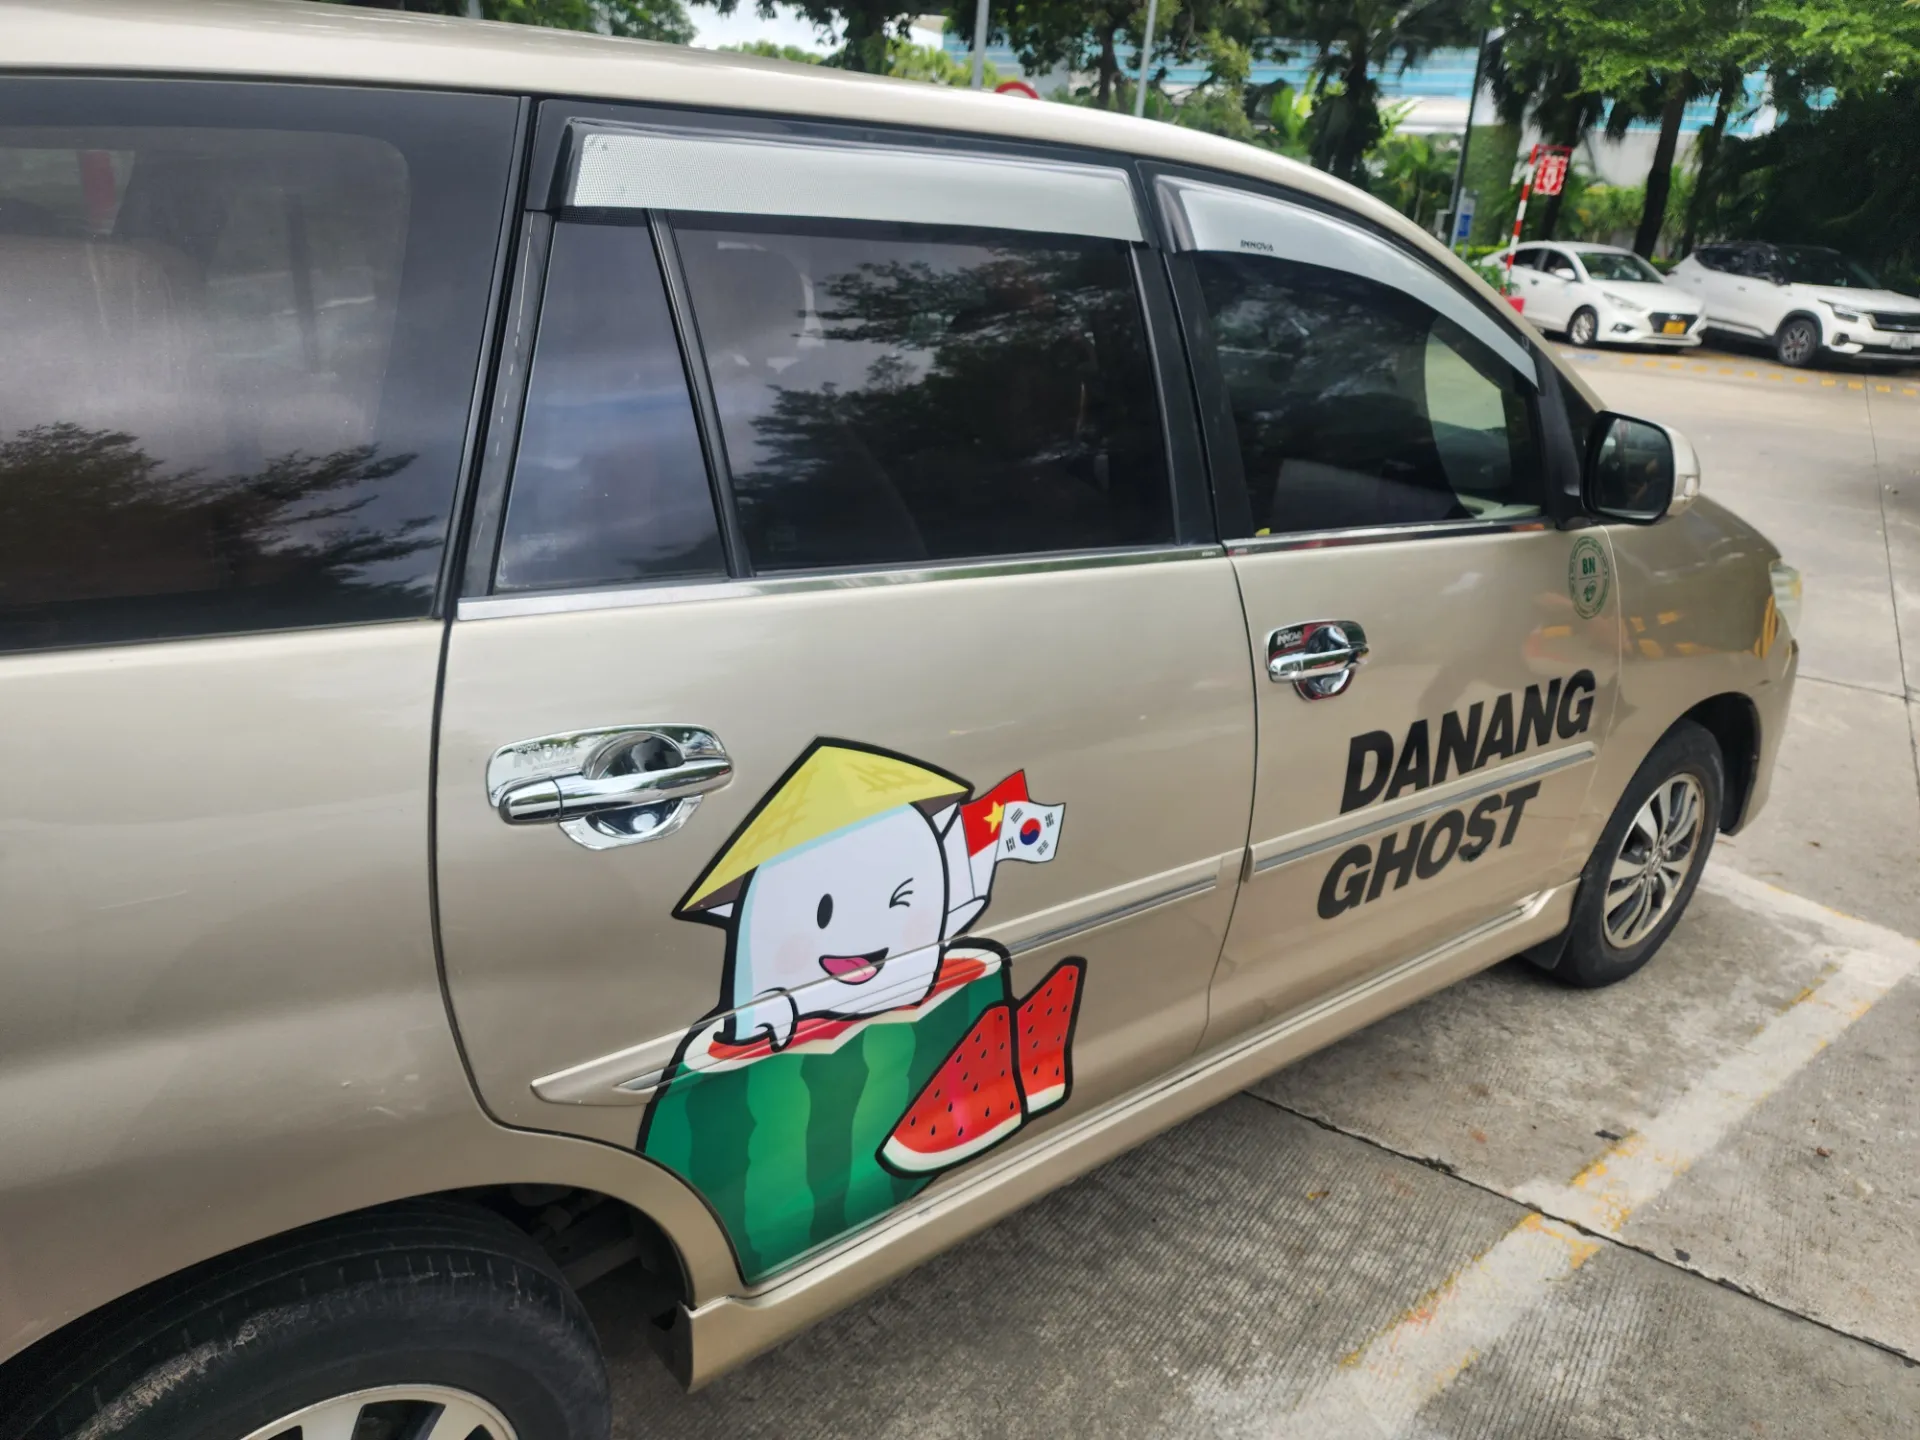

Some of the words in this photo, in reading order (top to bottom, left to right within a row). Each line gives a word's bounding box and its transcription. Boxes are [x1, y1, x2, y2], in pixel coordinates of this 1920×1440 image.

[1240, 239, 1274, 252] INNOVA
[1339, 668, 1596, 815] DANANG
[1316, 780, 1542, 920] GHOST
